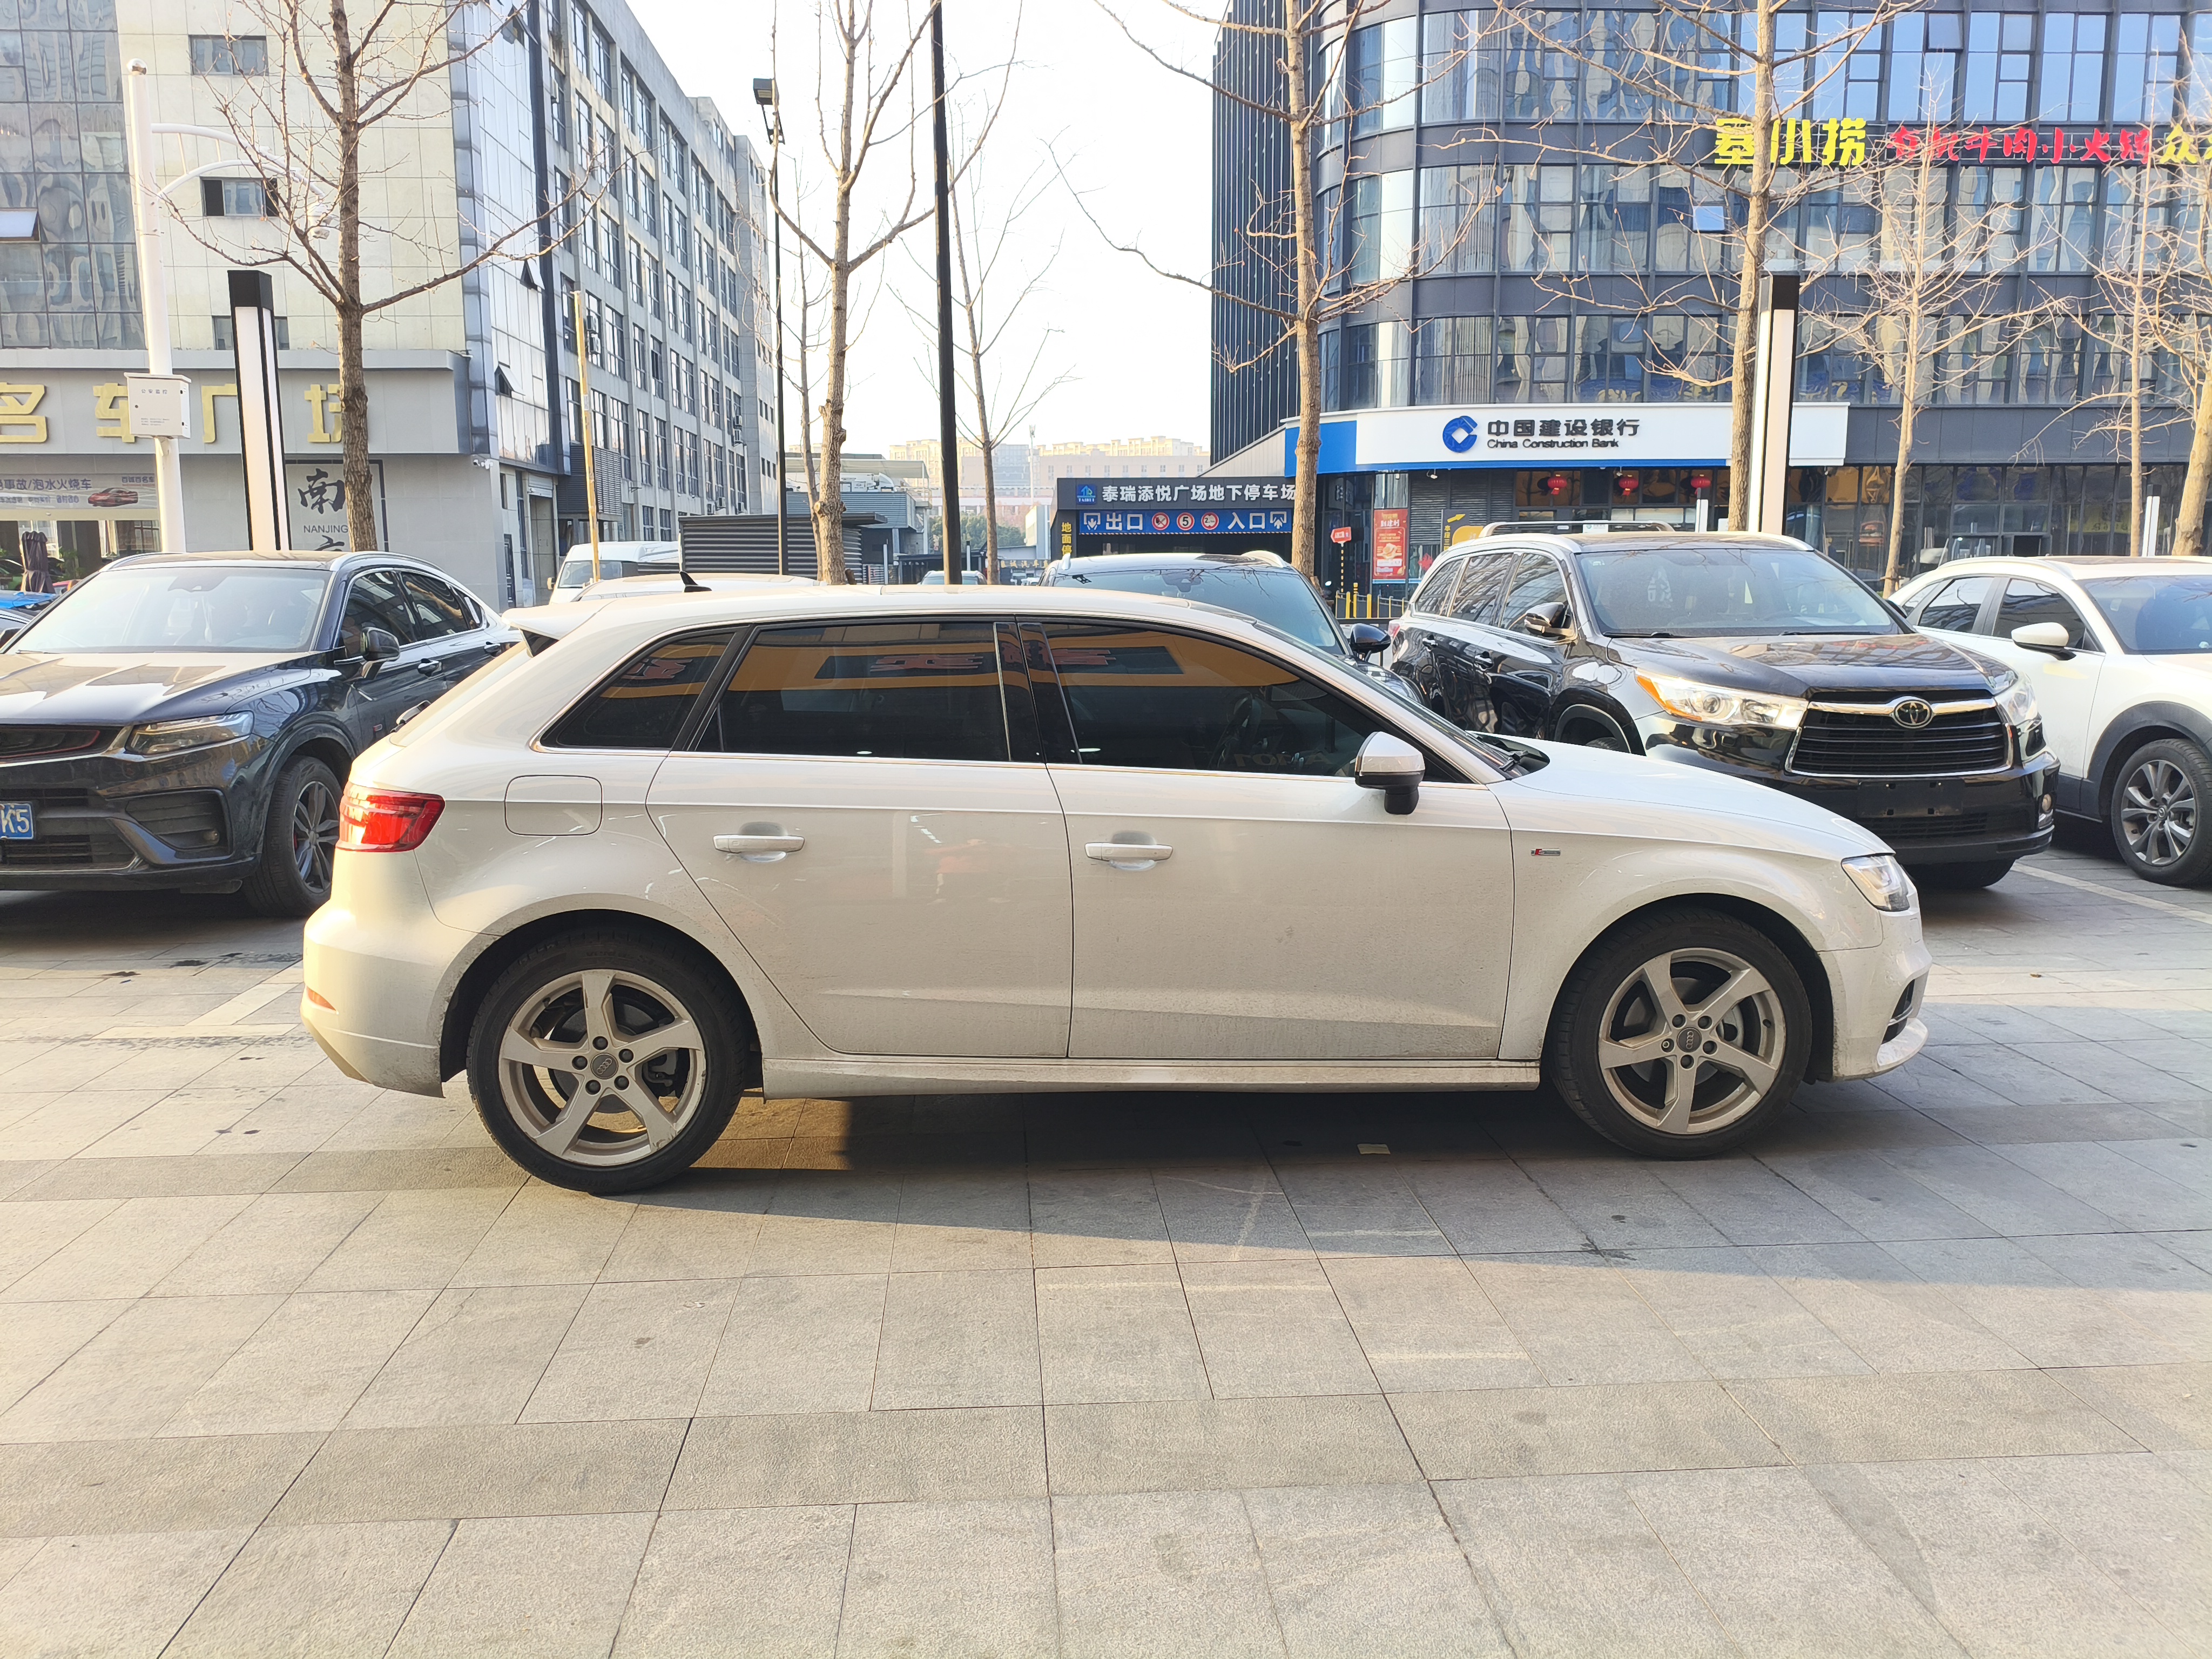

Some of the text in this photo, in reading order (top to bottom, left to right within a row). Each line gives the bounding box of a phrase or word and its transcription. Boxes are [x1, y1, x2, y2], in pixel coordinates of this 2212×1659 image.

[1487, 418, 1640, 437] 中国建设银行
[1487, 439, 1619, 449] China Construction Bank
[298, 468, 346, 515] 南
[1102, 484, 1296, 503] 泰瑞添悦广场地下停车场
[304, 524, 348, 534] NANJING
[1105, 512, 1143, 531] 出口
[1182, 516, 1189, 527] 5
[1228, 512, 1265, 530] 入口
